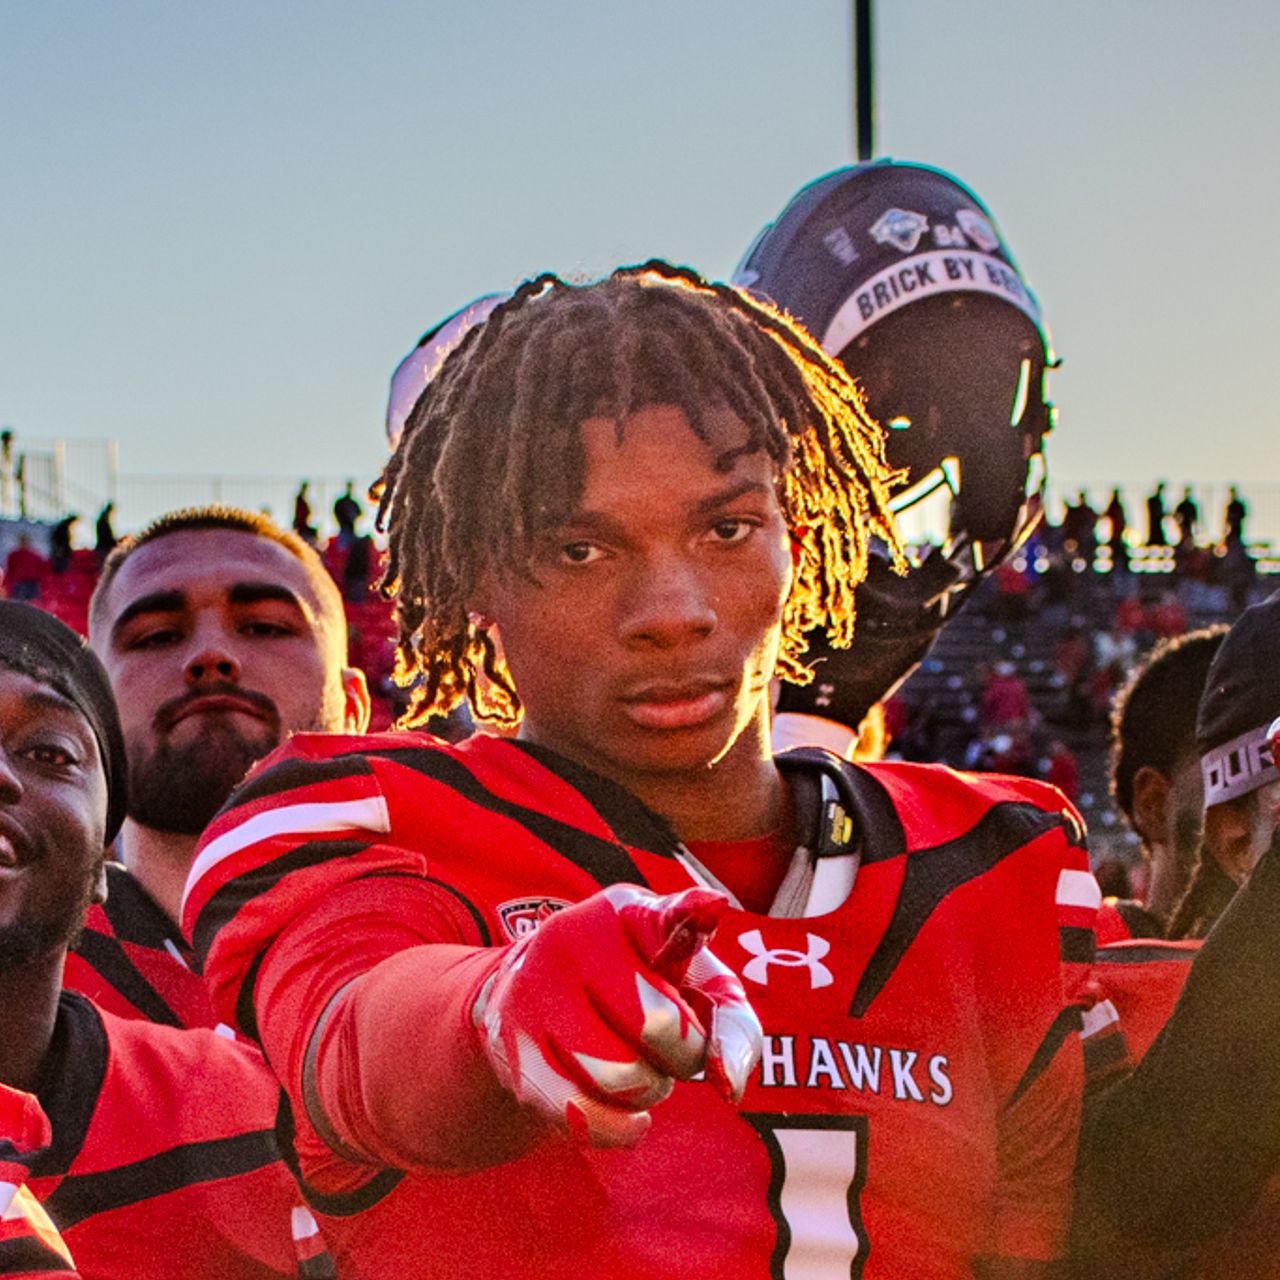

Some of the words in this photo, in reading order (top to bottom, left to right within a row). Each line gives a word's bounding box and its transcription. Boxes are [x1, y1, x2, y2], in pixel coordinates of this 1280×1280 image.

[857, 261, 936, 321] BRICK
[943, 257, 975, 281] BY
[689, 1035, 954, 1106] HAWKS
